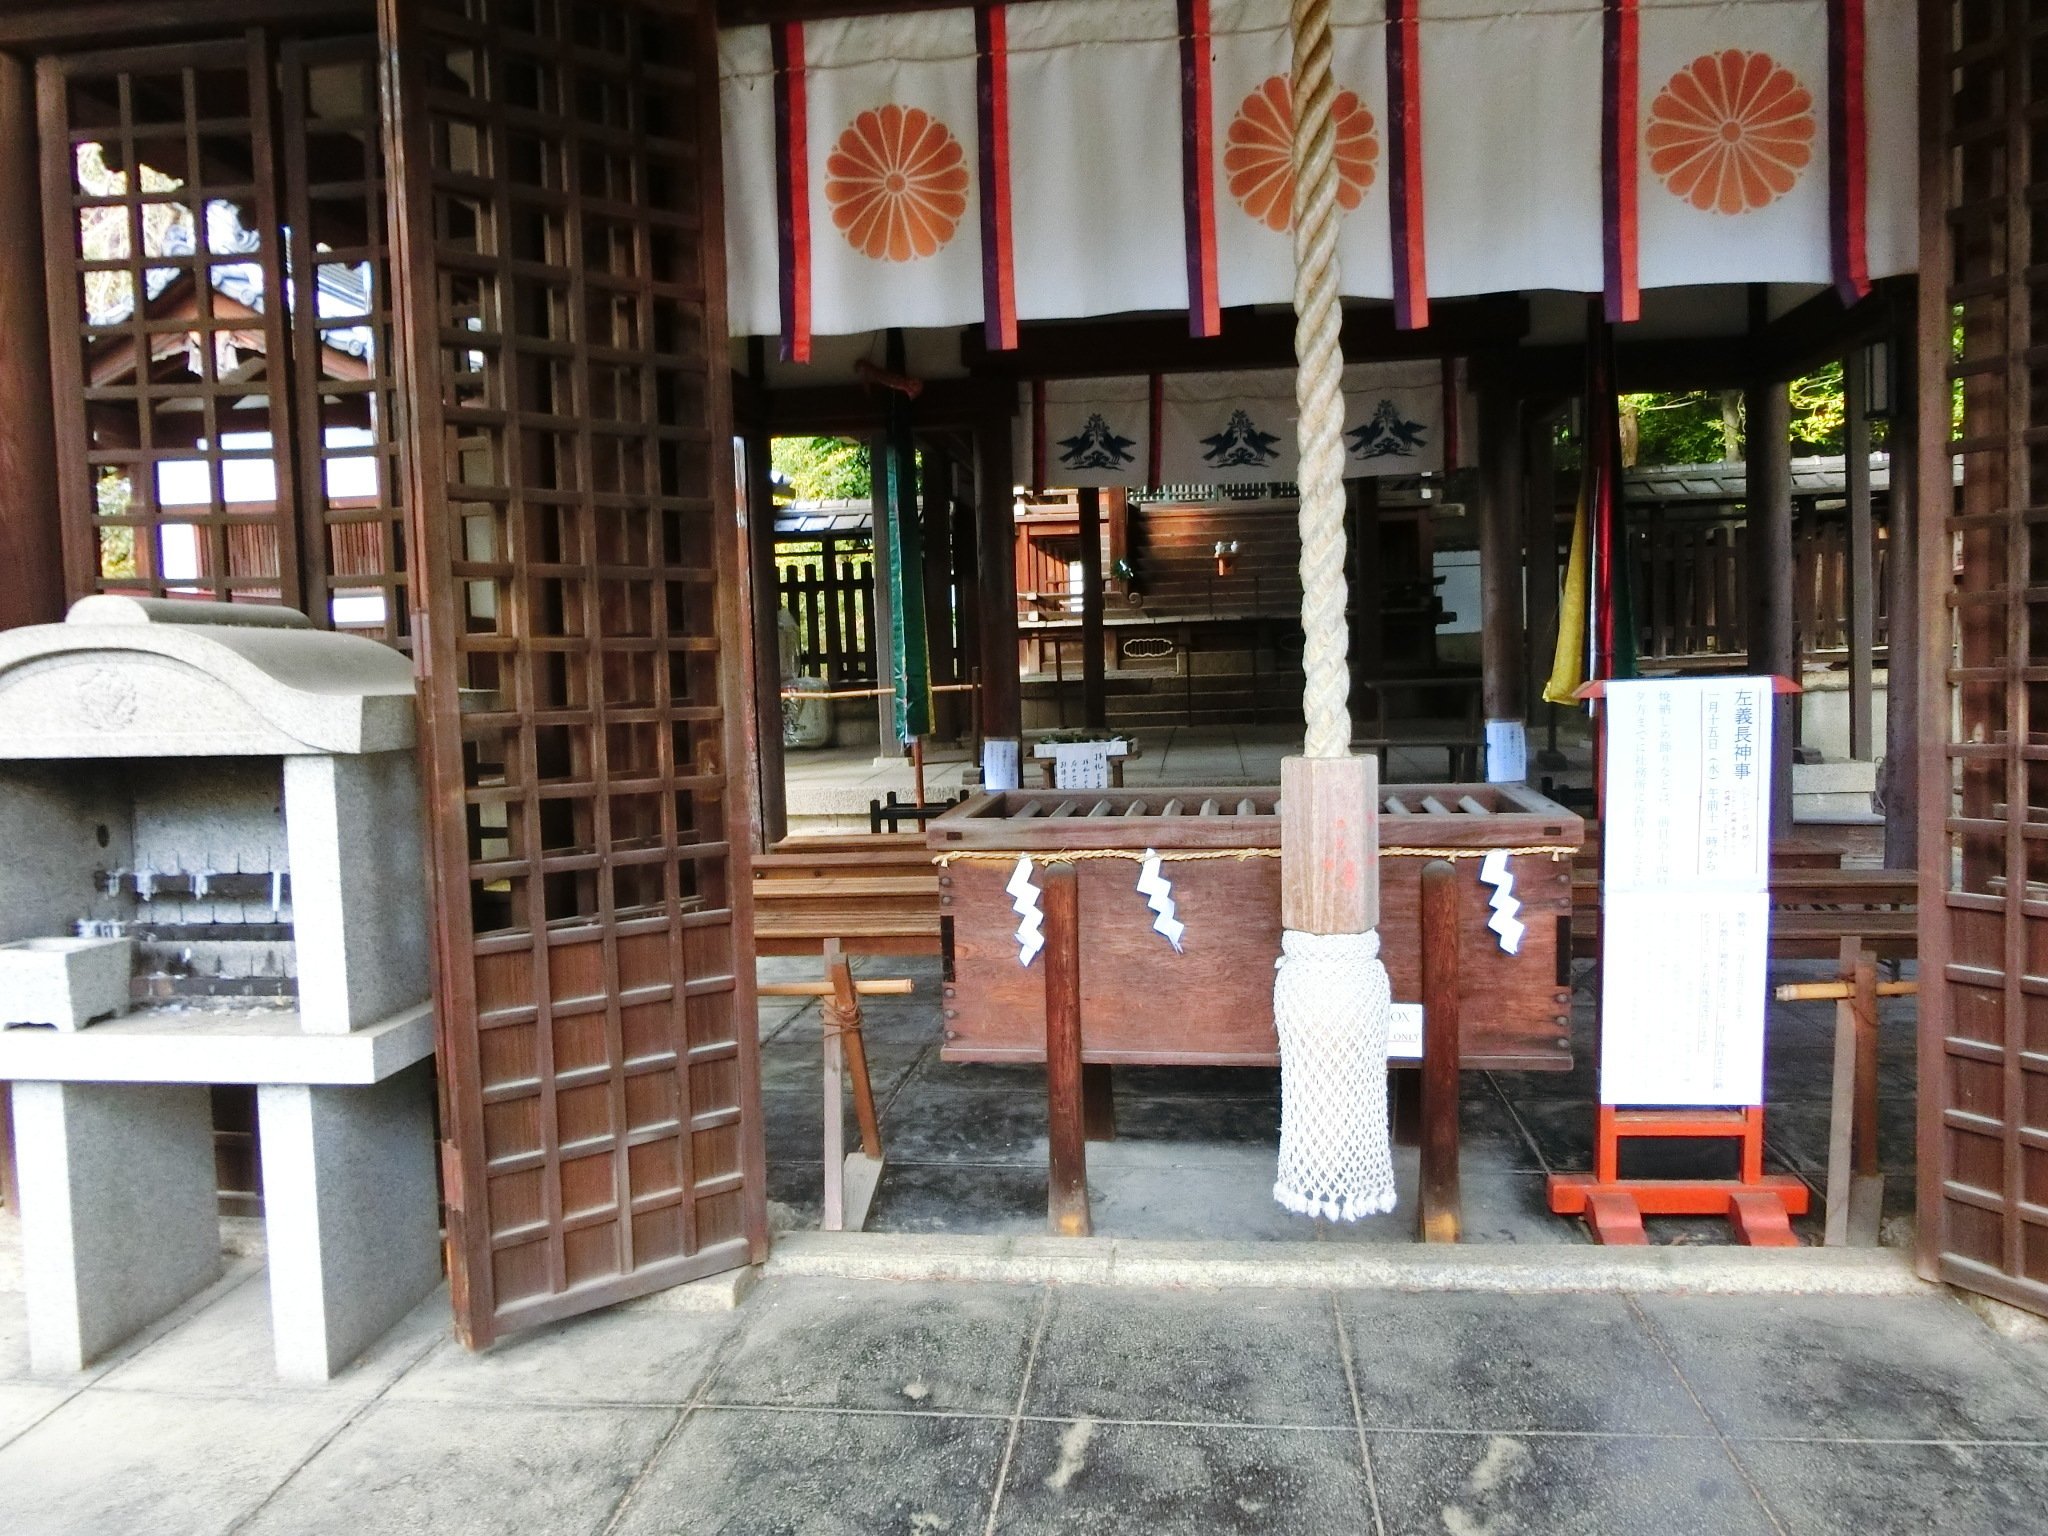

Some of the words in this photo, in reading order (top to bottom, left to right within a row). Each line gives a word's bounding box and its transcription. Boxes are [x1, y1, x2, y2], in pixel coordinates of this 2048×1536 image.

[1734, 688, 1753, 780] 左義長神事
